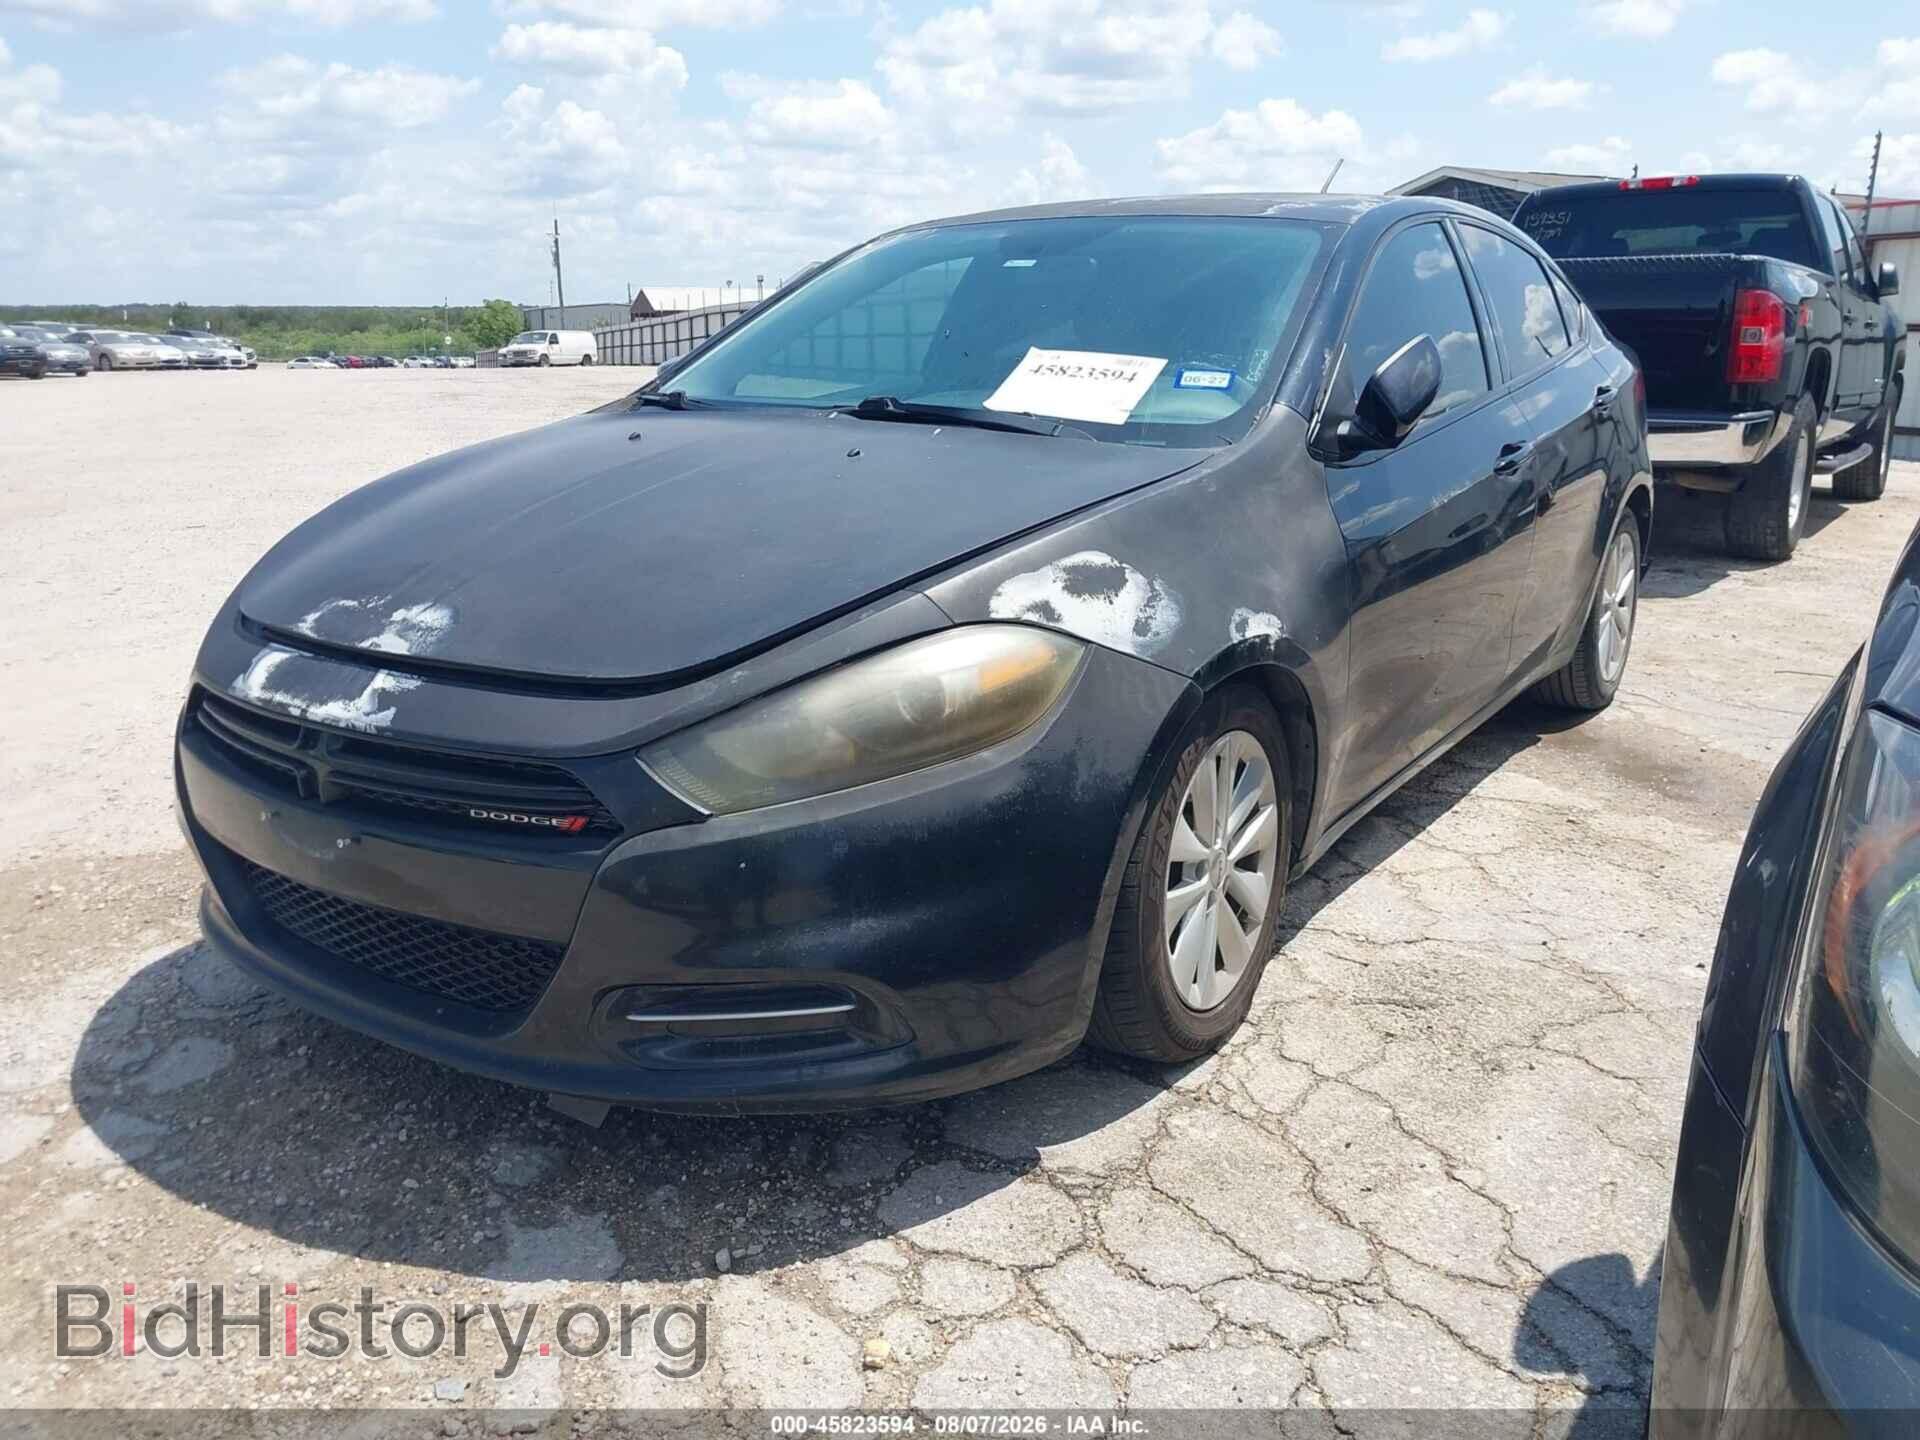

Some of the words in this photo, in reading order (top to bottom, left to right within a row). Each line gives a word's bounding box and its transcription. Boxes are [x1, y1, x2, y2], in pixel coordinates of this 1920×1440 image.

[1029, 363, 1138, 383] 45823594
[1182, 374, 1227, 385] 06-27
[470, 808, 571, 827] DODGE
